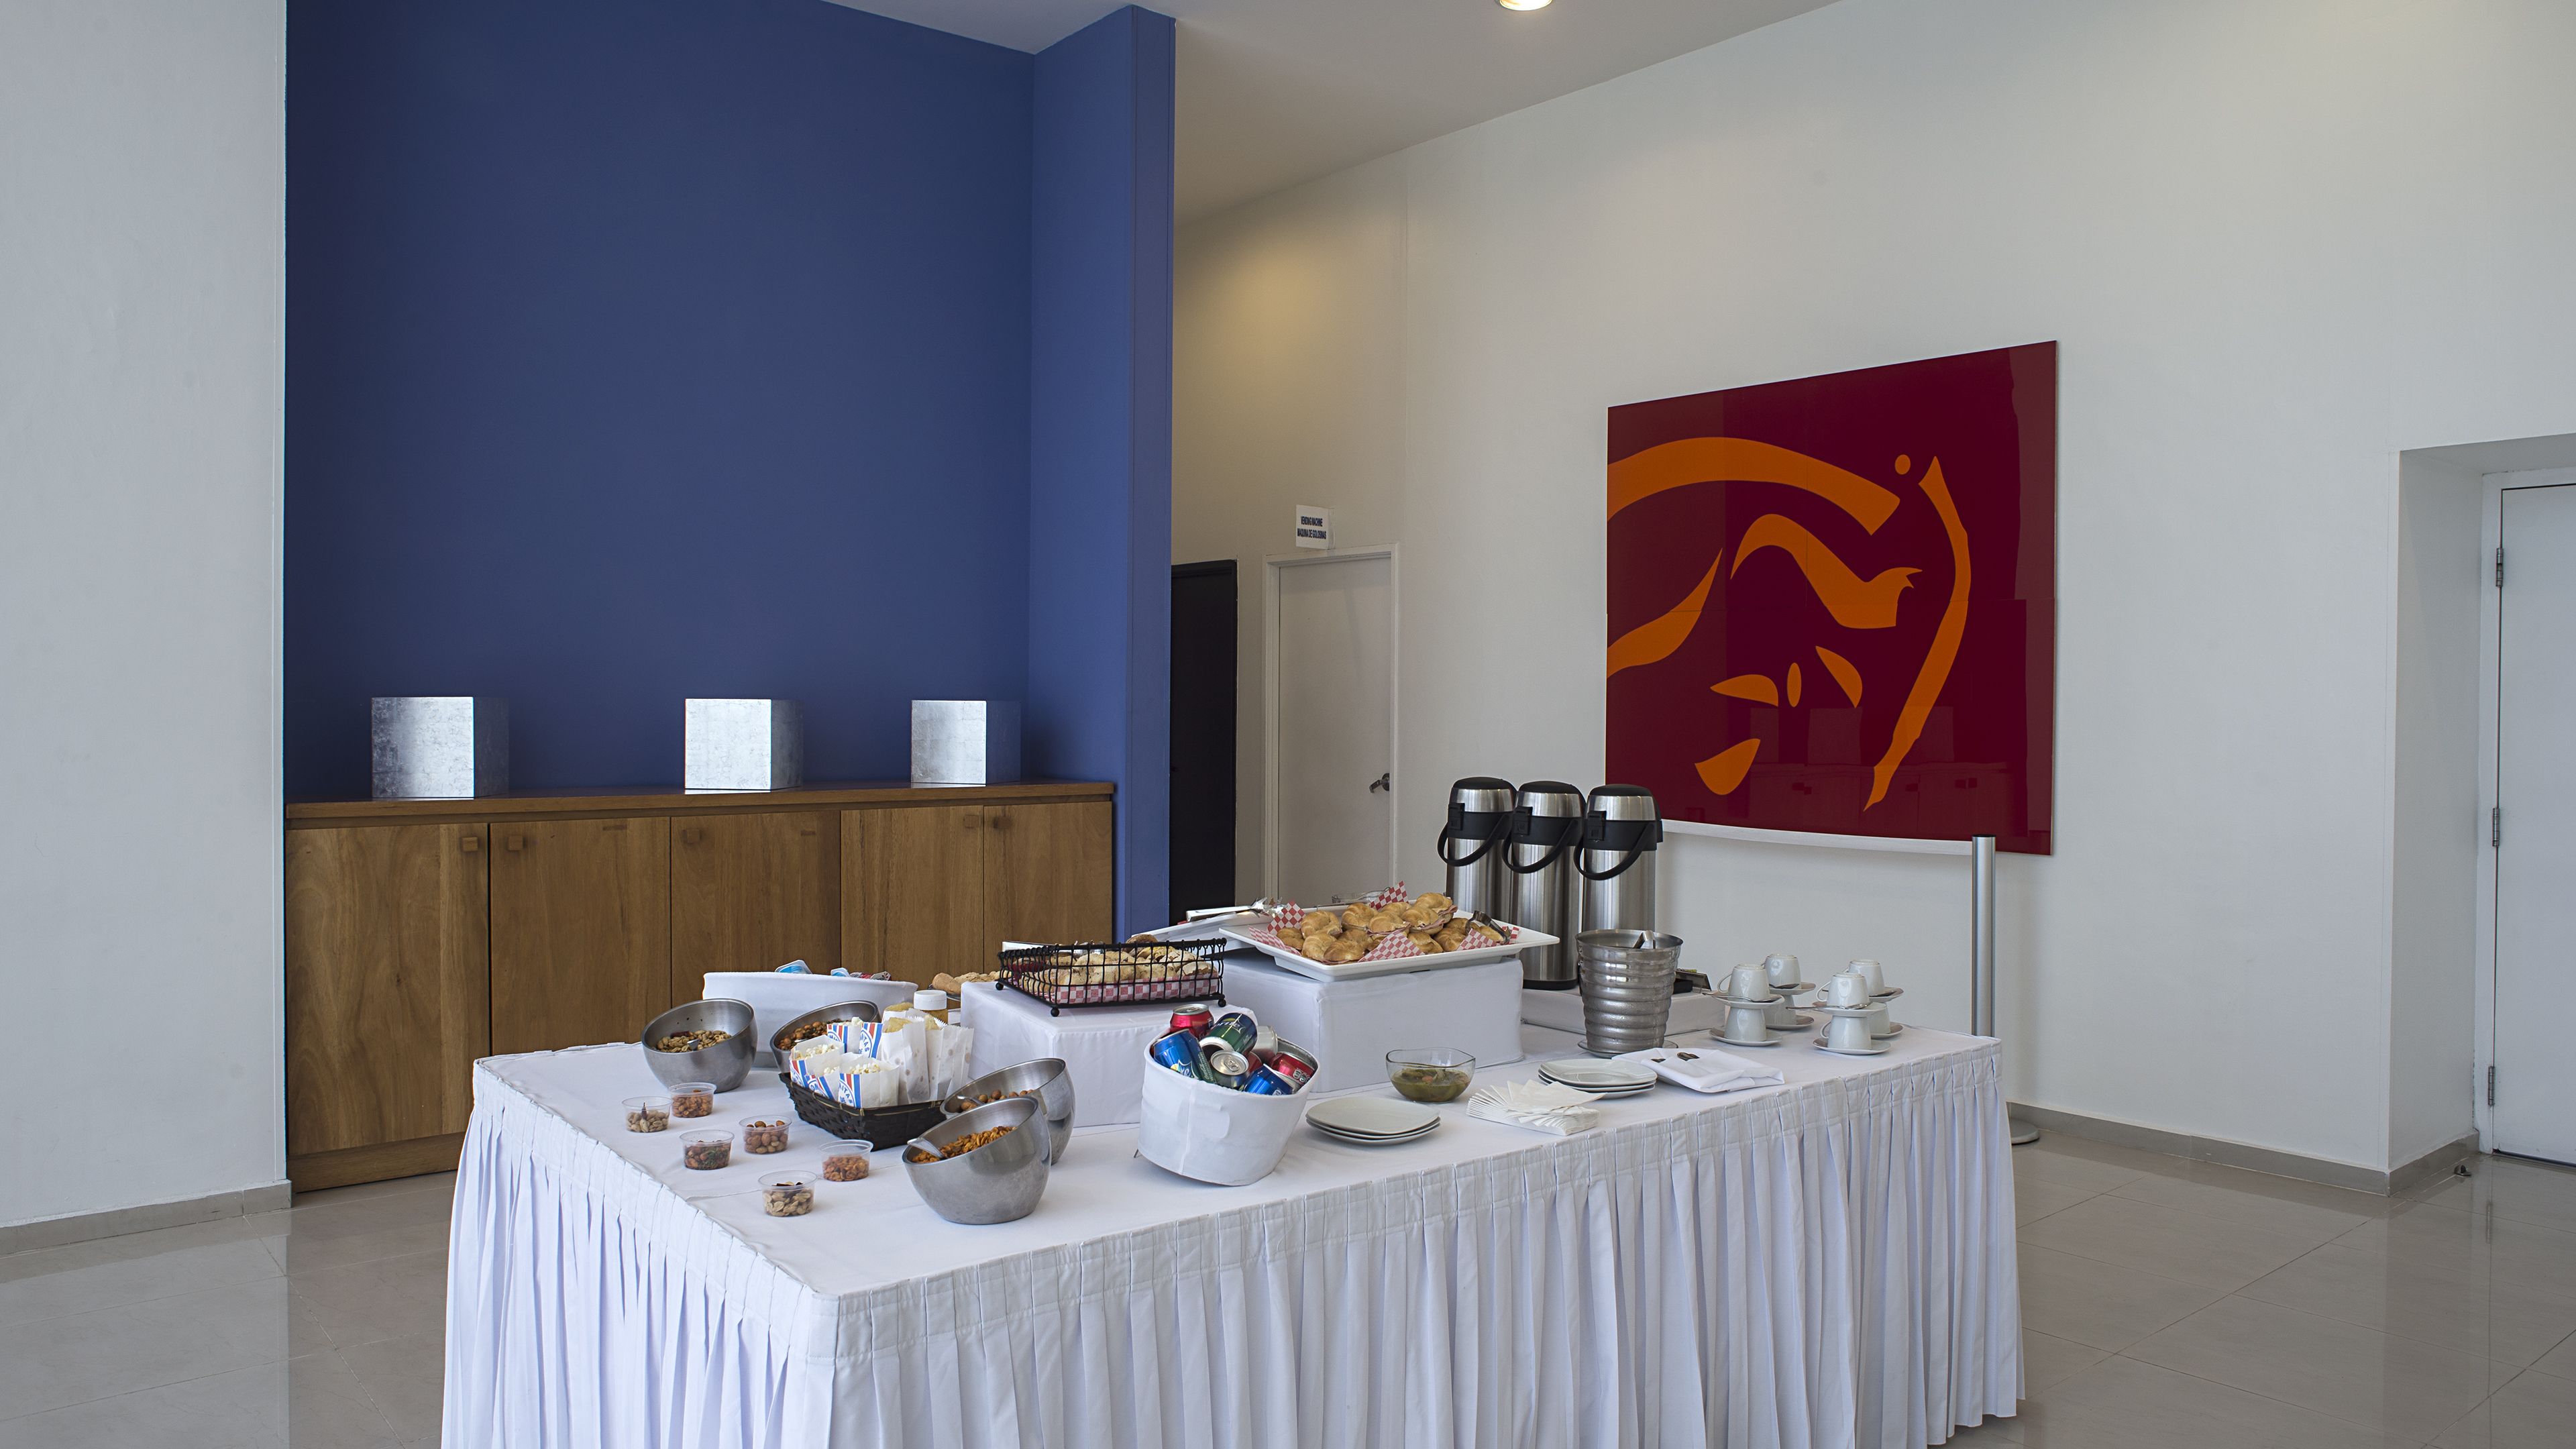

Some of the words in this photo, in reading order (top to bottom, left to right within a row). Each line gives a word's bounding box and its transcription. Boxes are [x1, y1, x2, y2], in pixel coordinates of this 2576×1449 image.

[1301, 516, 1311, 525] VENDING
[1312, 517, 1323, 527] MACHINE
[1309, 529, 1312, 538] DE
[1313, 530, 1326, 539] GOLOSINAS
